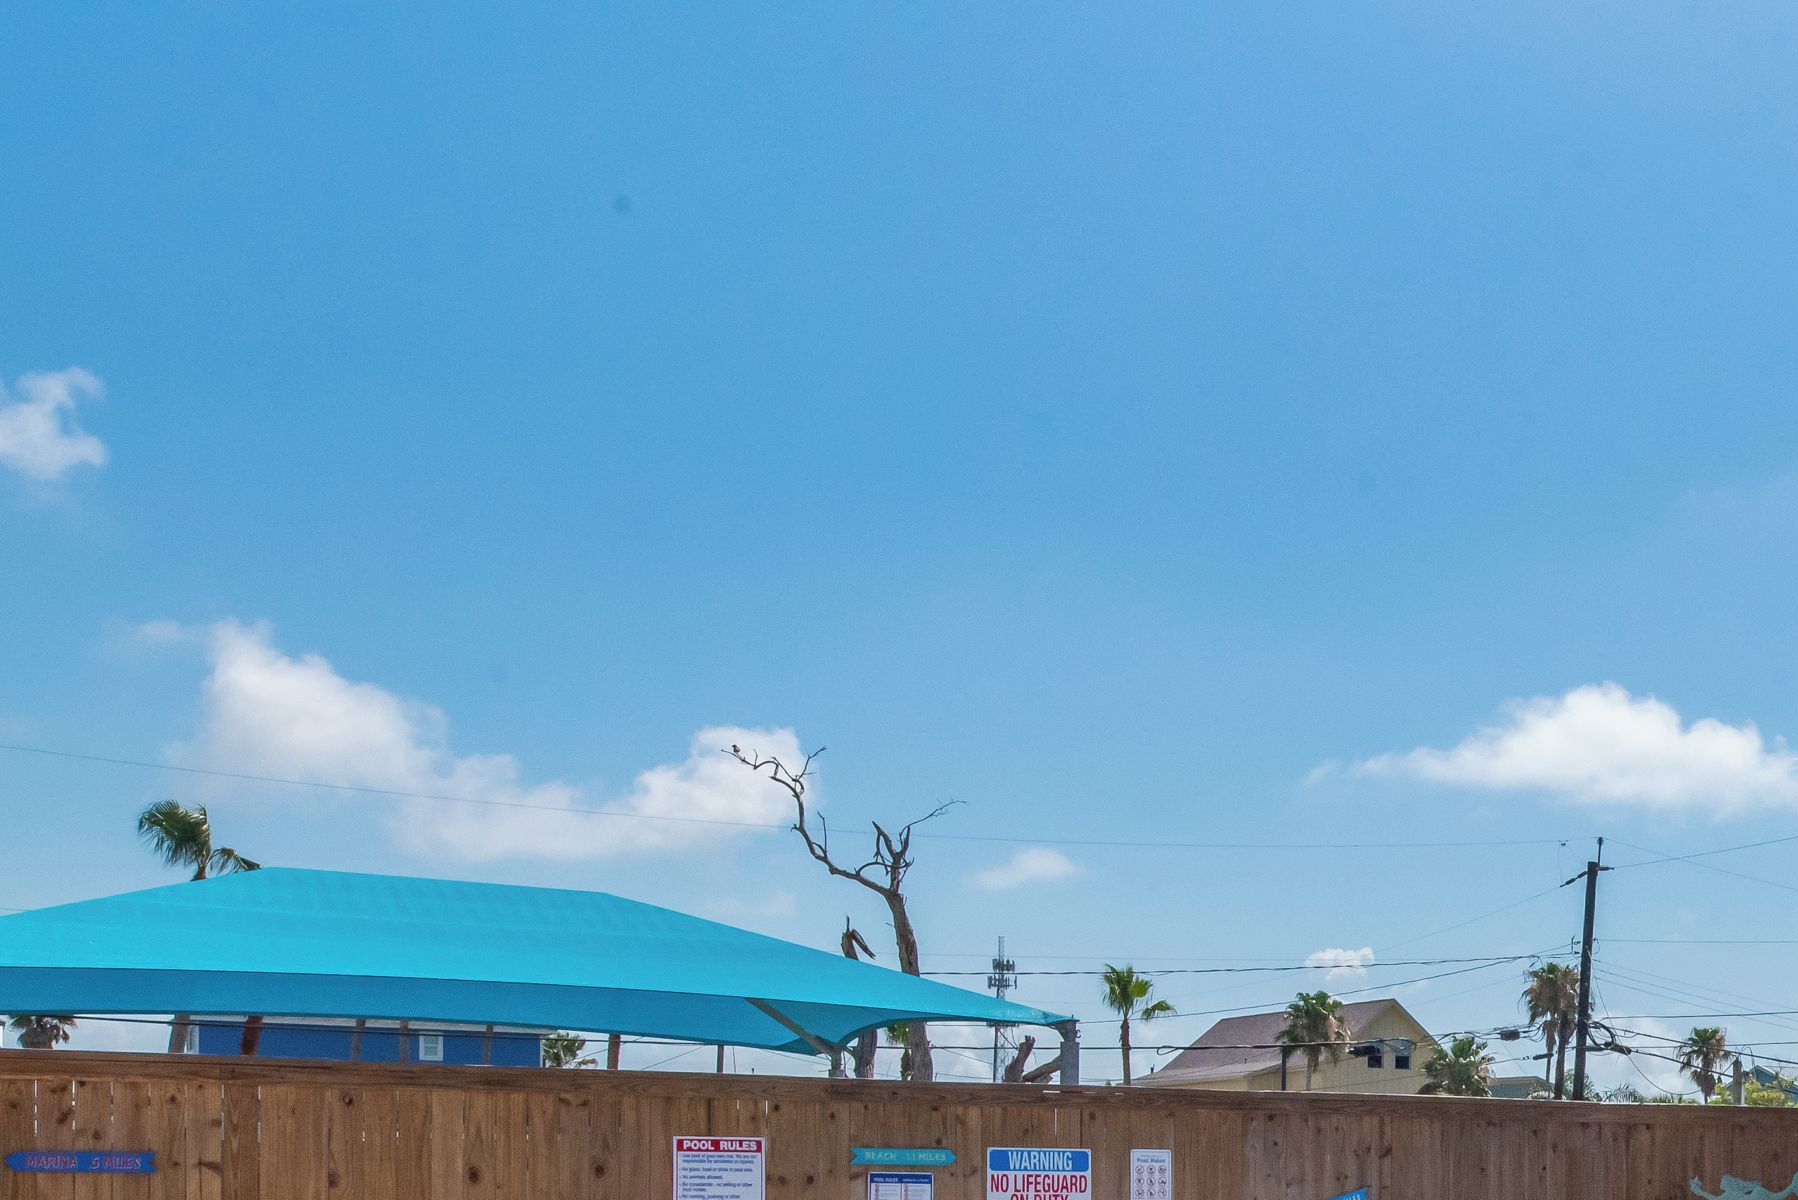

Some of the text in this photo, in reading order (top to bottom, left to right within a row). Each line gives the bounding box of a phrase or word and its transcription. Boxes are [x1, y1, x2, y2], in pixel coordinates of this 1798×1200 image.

[683, 1140, 757, 1151] POOL RULES
[27, 1156, 78, 1169] MARINA
[104, 1156, 141, 1169] MILES
[865, 1151, 897, 1160] BEACH
[918, 1153, 946, 1161] MILES
[1008, 1151, 1073, 1170] WARNING
[991, 1174, 1088, 1193] NO LIFEGUARD
